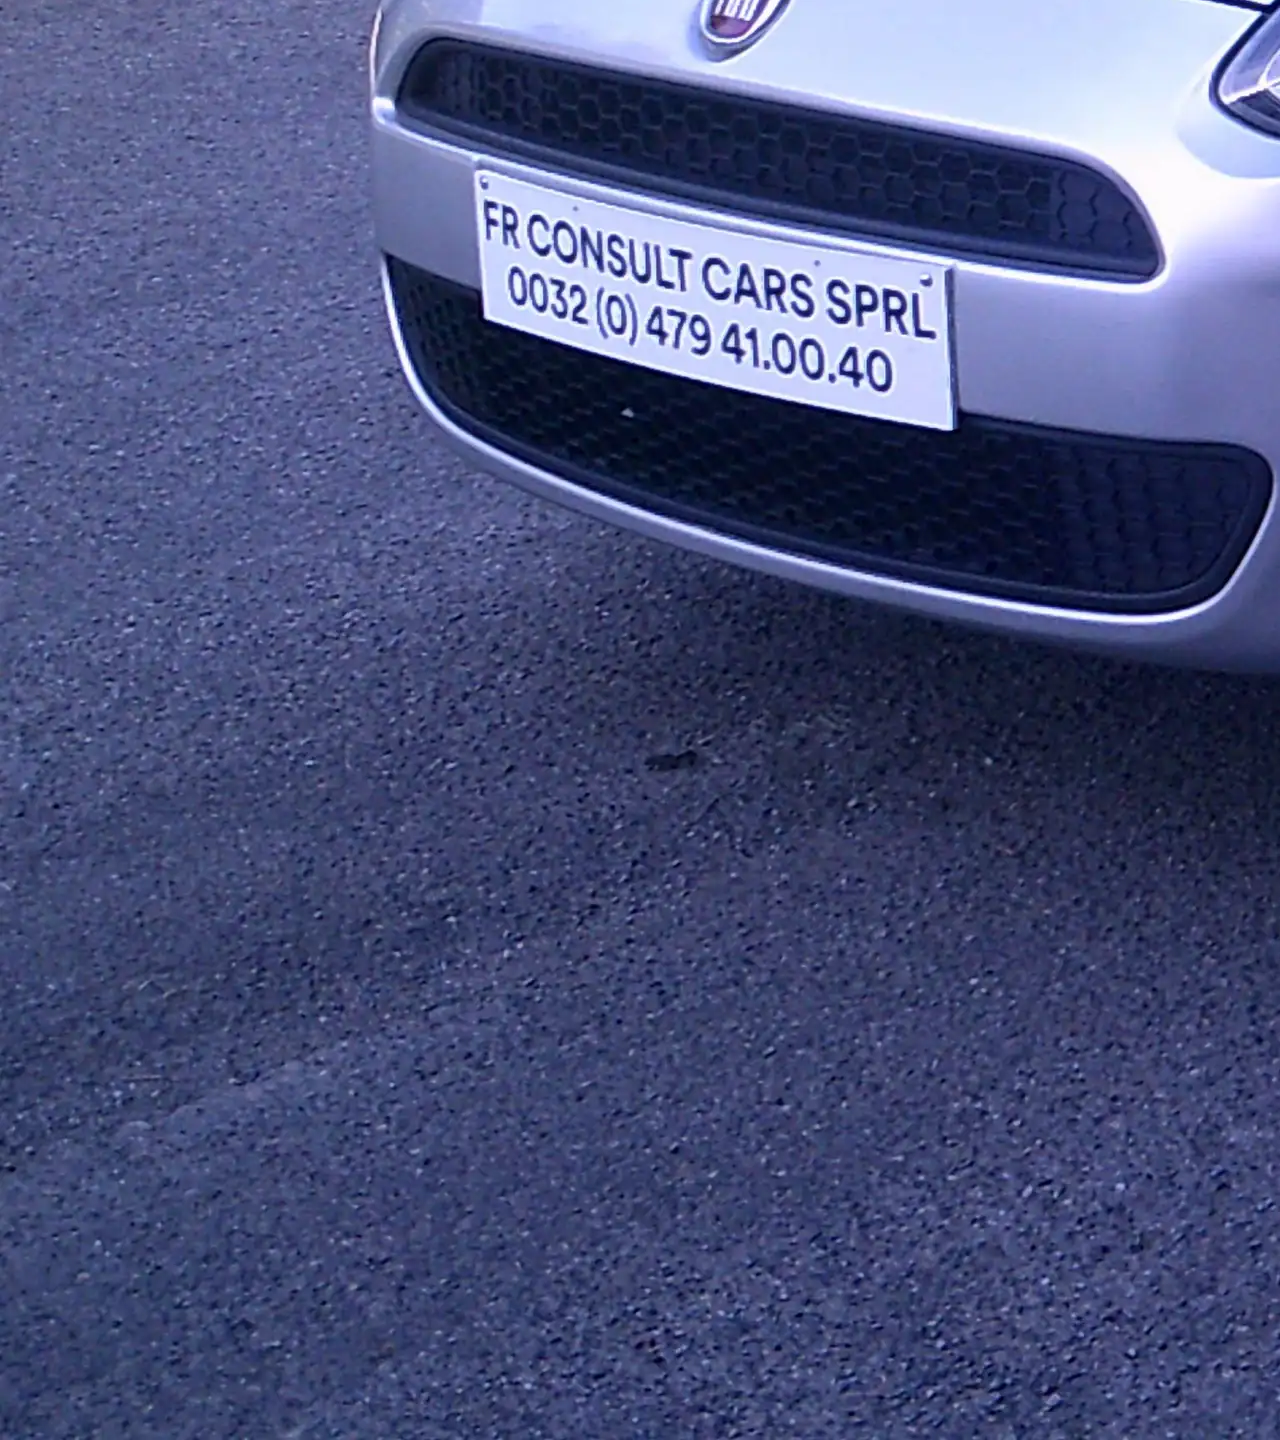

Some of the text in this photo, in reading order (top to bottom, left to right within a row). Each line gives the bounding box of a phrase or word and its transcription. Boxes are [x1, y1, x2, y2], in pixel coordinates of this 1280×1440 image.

[483, 199, 937, 340] FR CONSULT CARS SPRL
[508, 266, 893, 393] 0032 (0) 479 41.00.40
